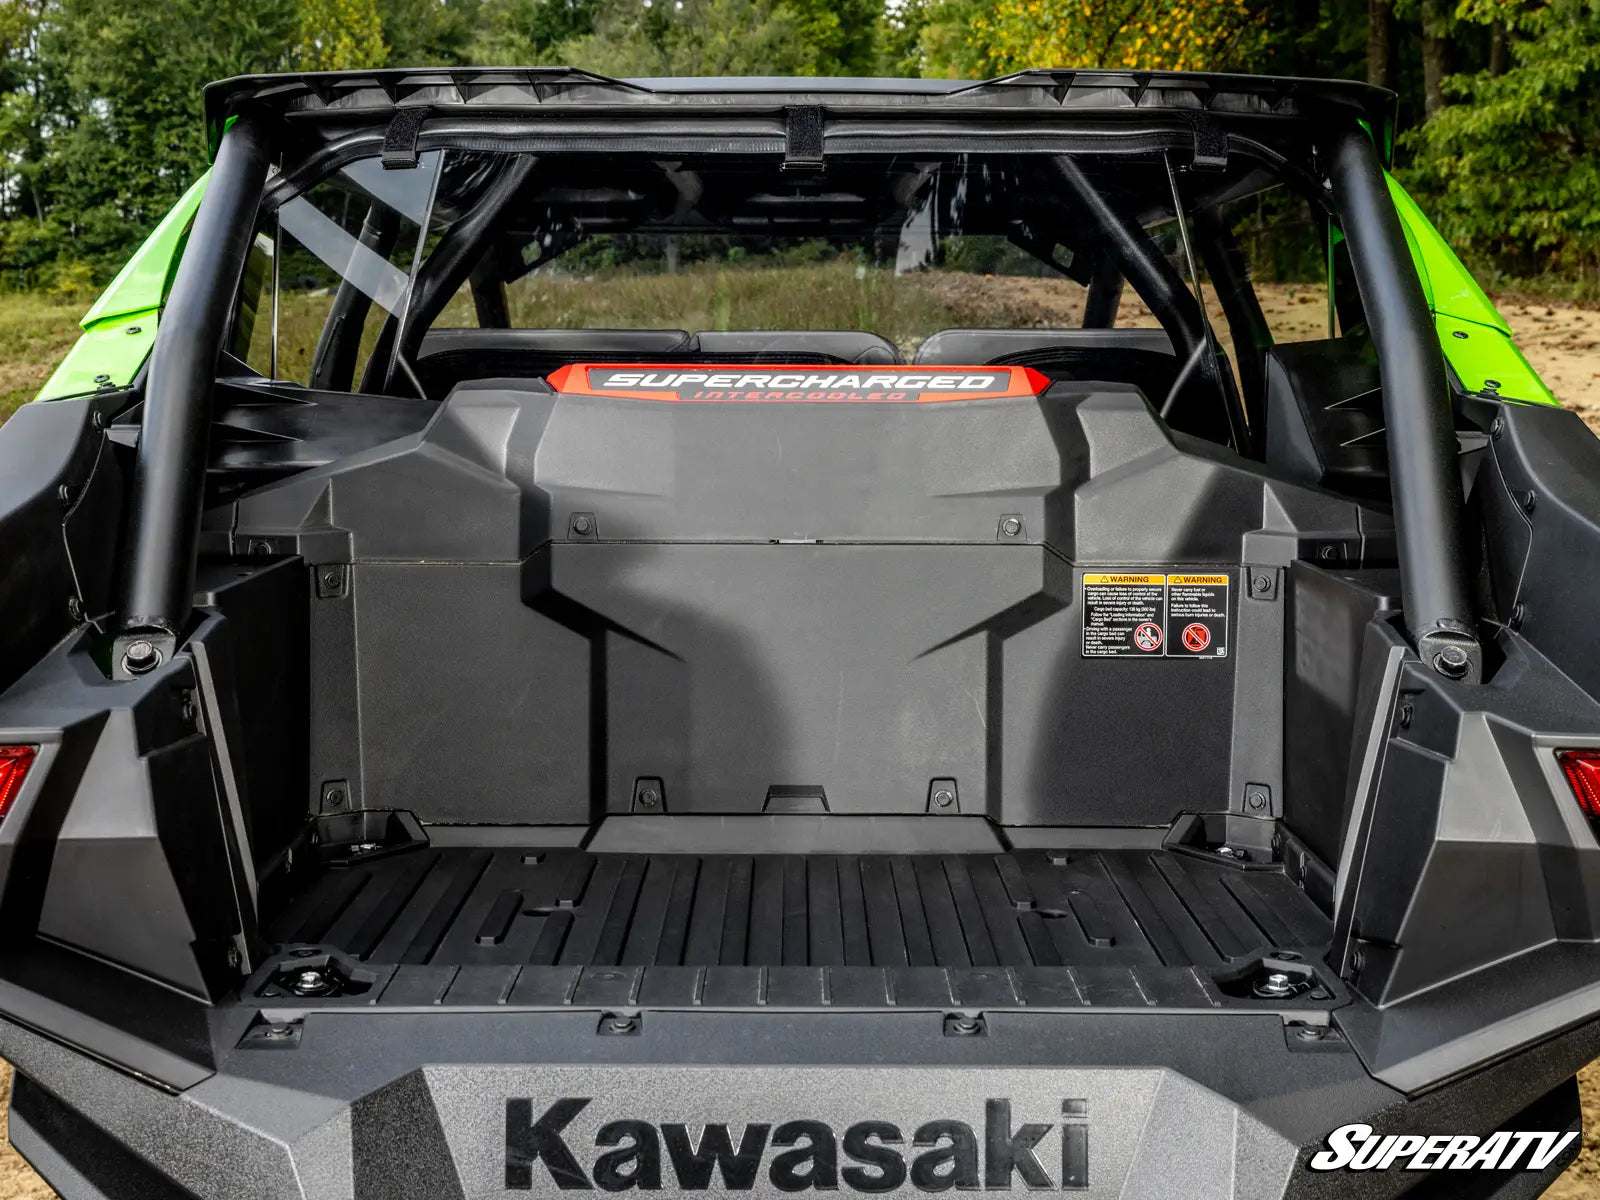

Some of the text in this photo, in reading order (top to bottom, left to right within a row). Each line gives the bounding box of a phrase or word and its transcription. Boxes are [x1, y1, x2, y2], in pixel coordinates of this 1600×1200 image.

[603, 373, 996, 390] SUPERCHARGED
[693, 391, 906, 400] INTERCOOLED
[505, 1097, 1089, 1193] Kawasaki
